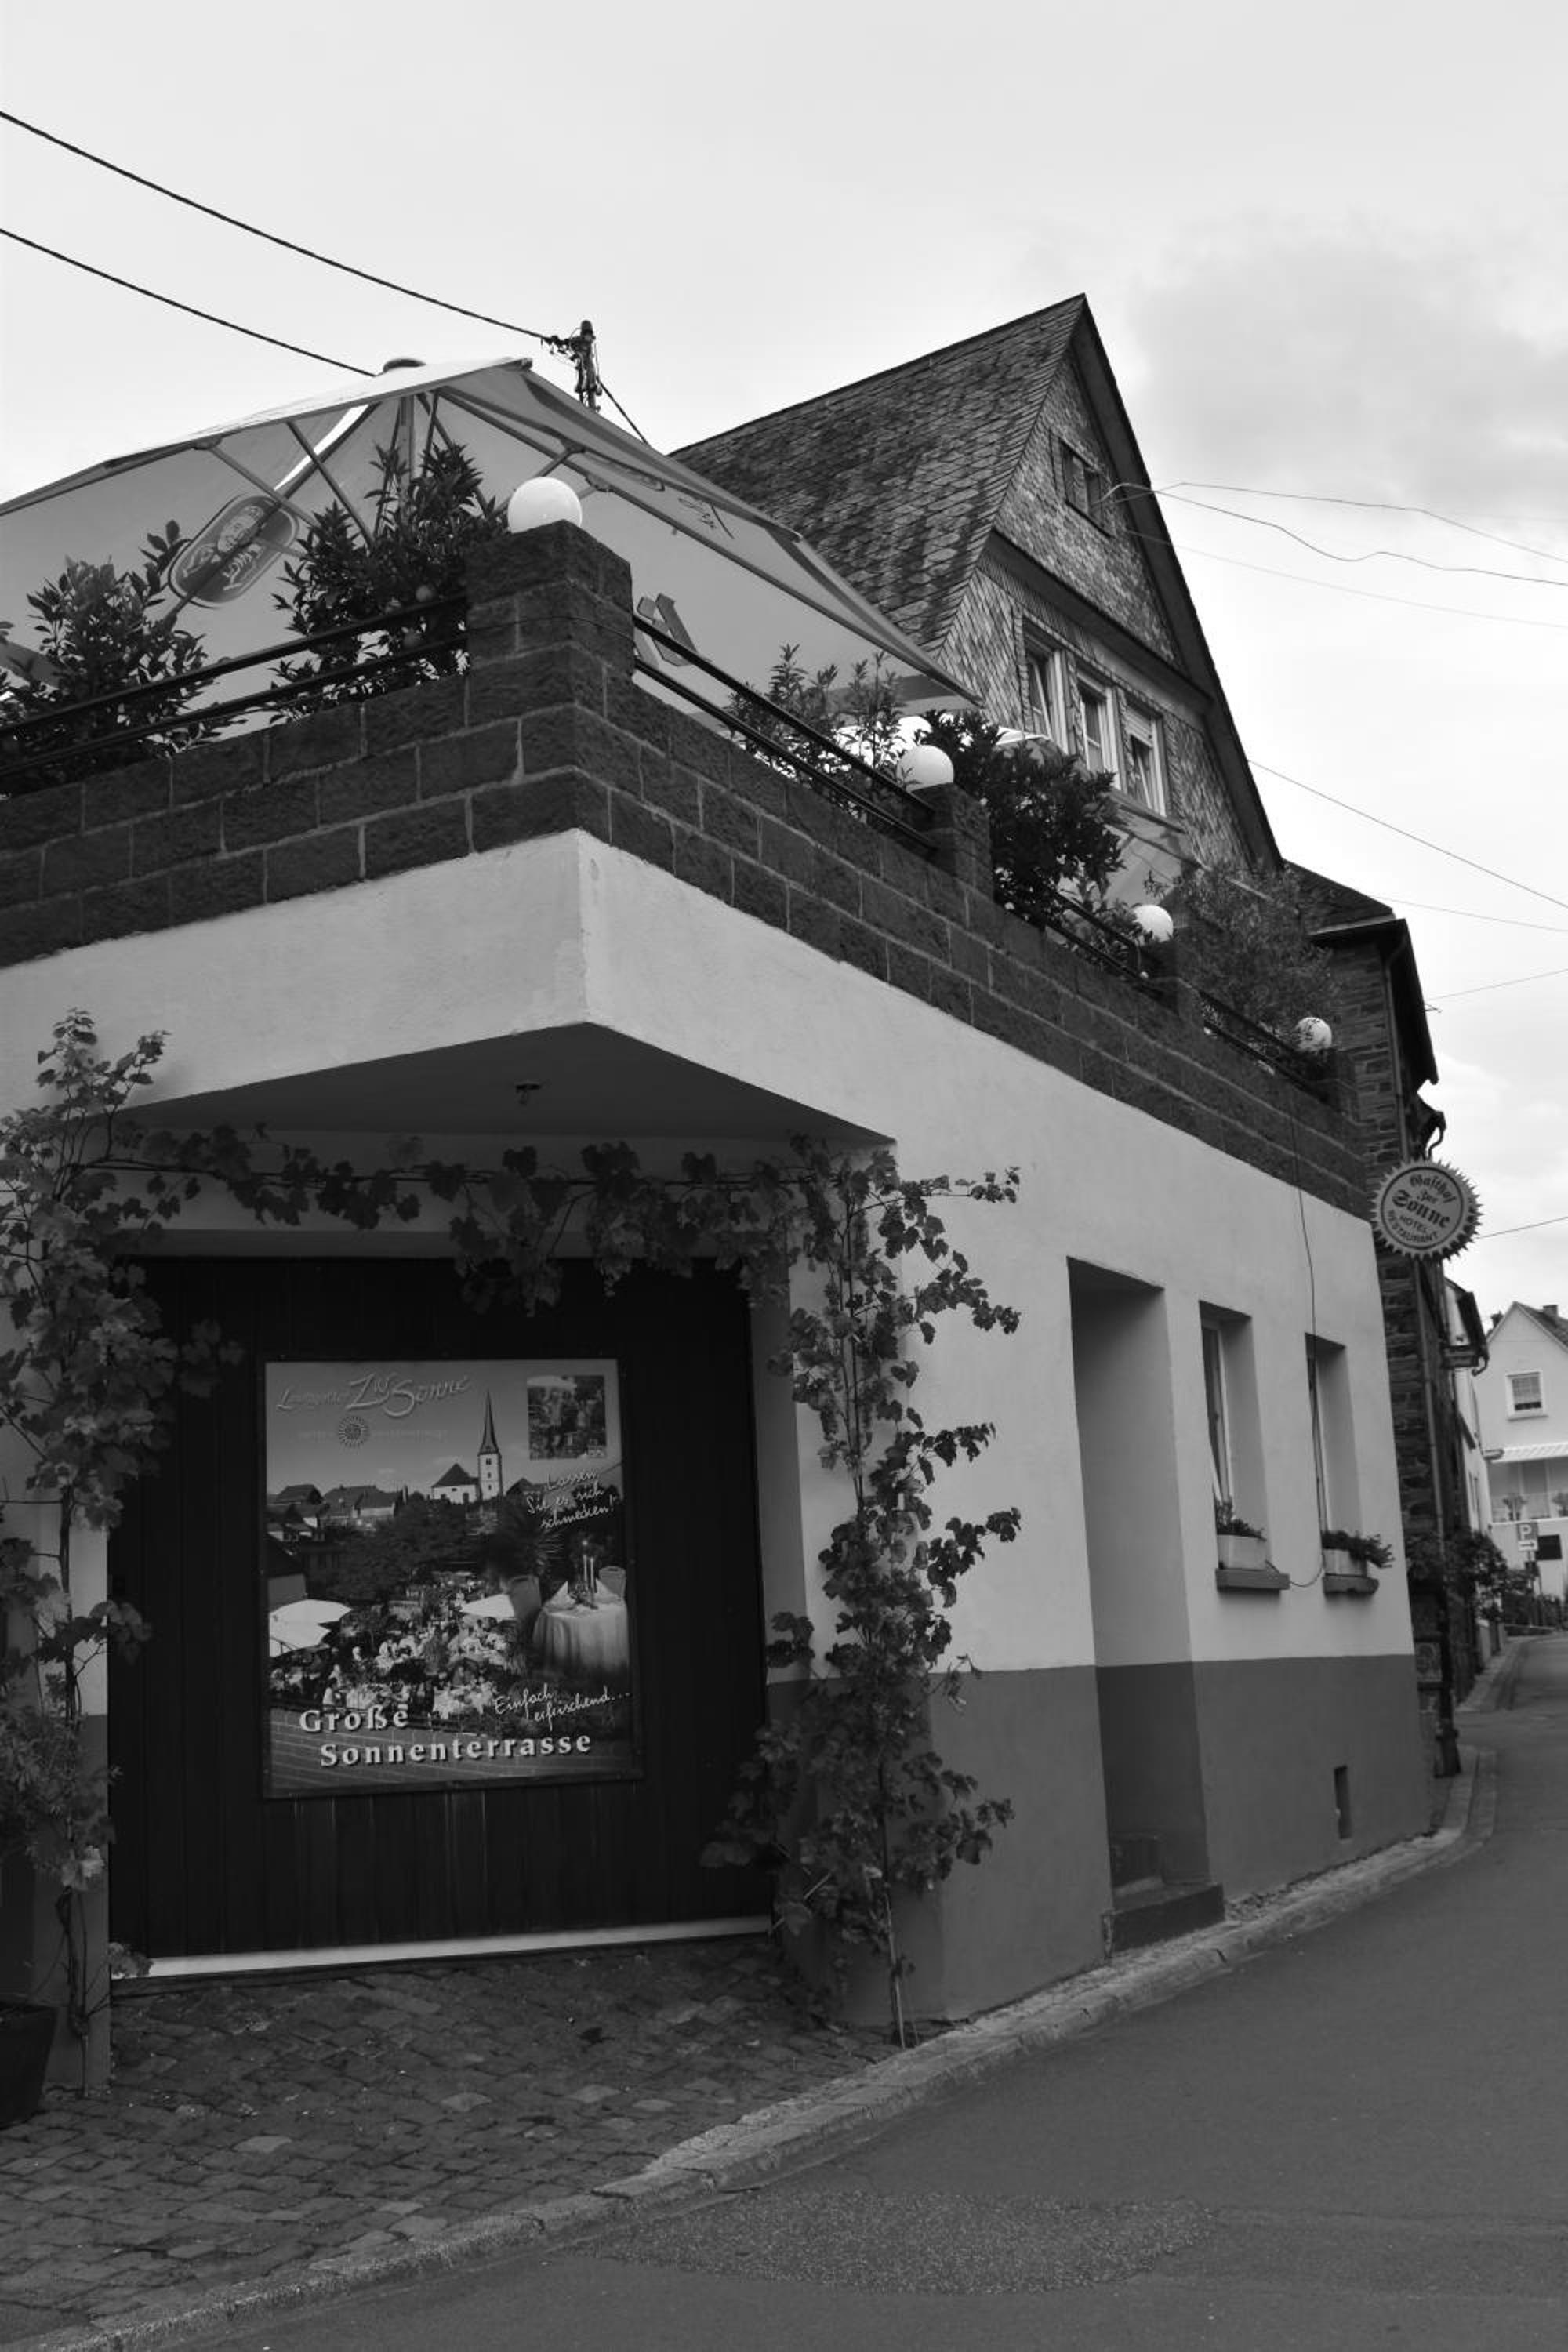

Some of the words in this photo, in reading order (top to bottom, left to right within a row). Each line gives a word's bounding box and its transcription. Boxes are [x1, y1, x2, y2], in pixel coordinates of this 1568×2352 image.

[1392, 1189, 1450, 1228] Sonne
[1399, 1215, 1428, 1232] HOTEL
[1388, 1210, 1438, 1243] RESTAURANT
[539, 1494, 616, 1529] schmecken!
[1519, 1524, 1532, 1541] P
[492, 1682, 554, 1720] Einfach
[298, 1704, 408, 1733] Große
[320, 1733, 592, 1767] Sonnenterrasse
